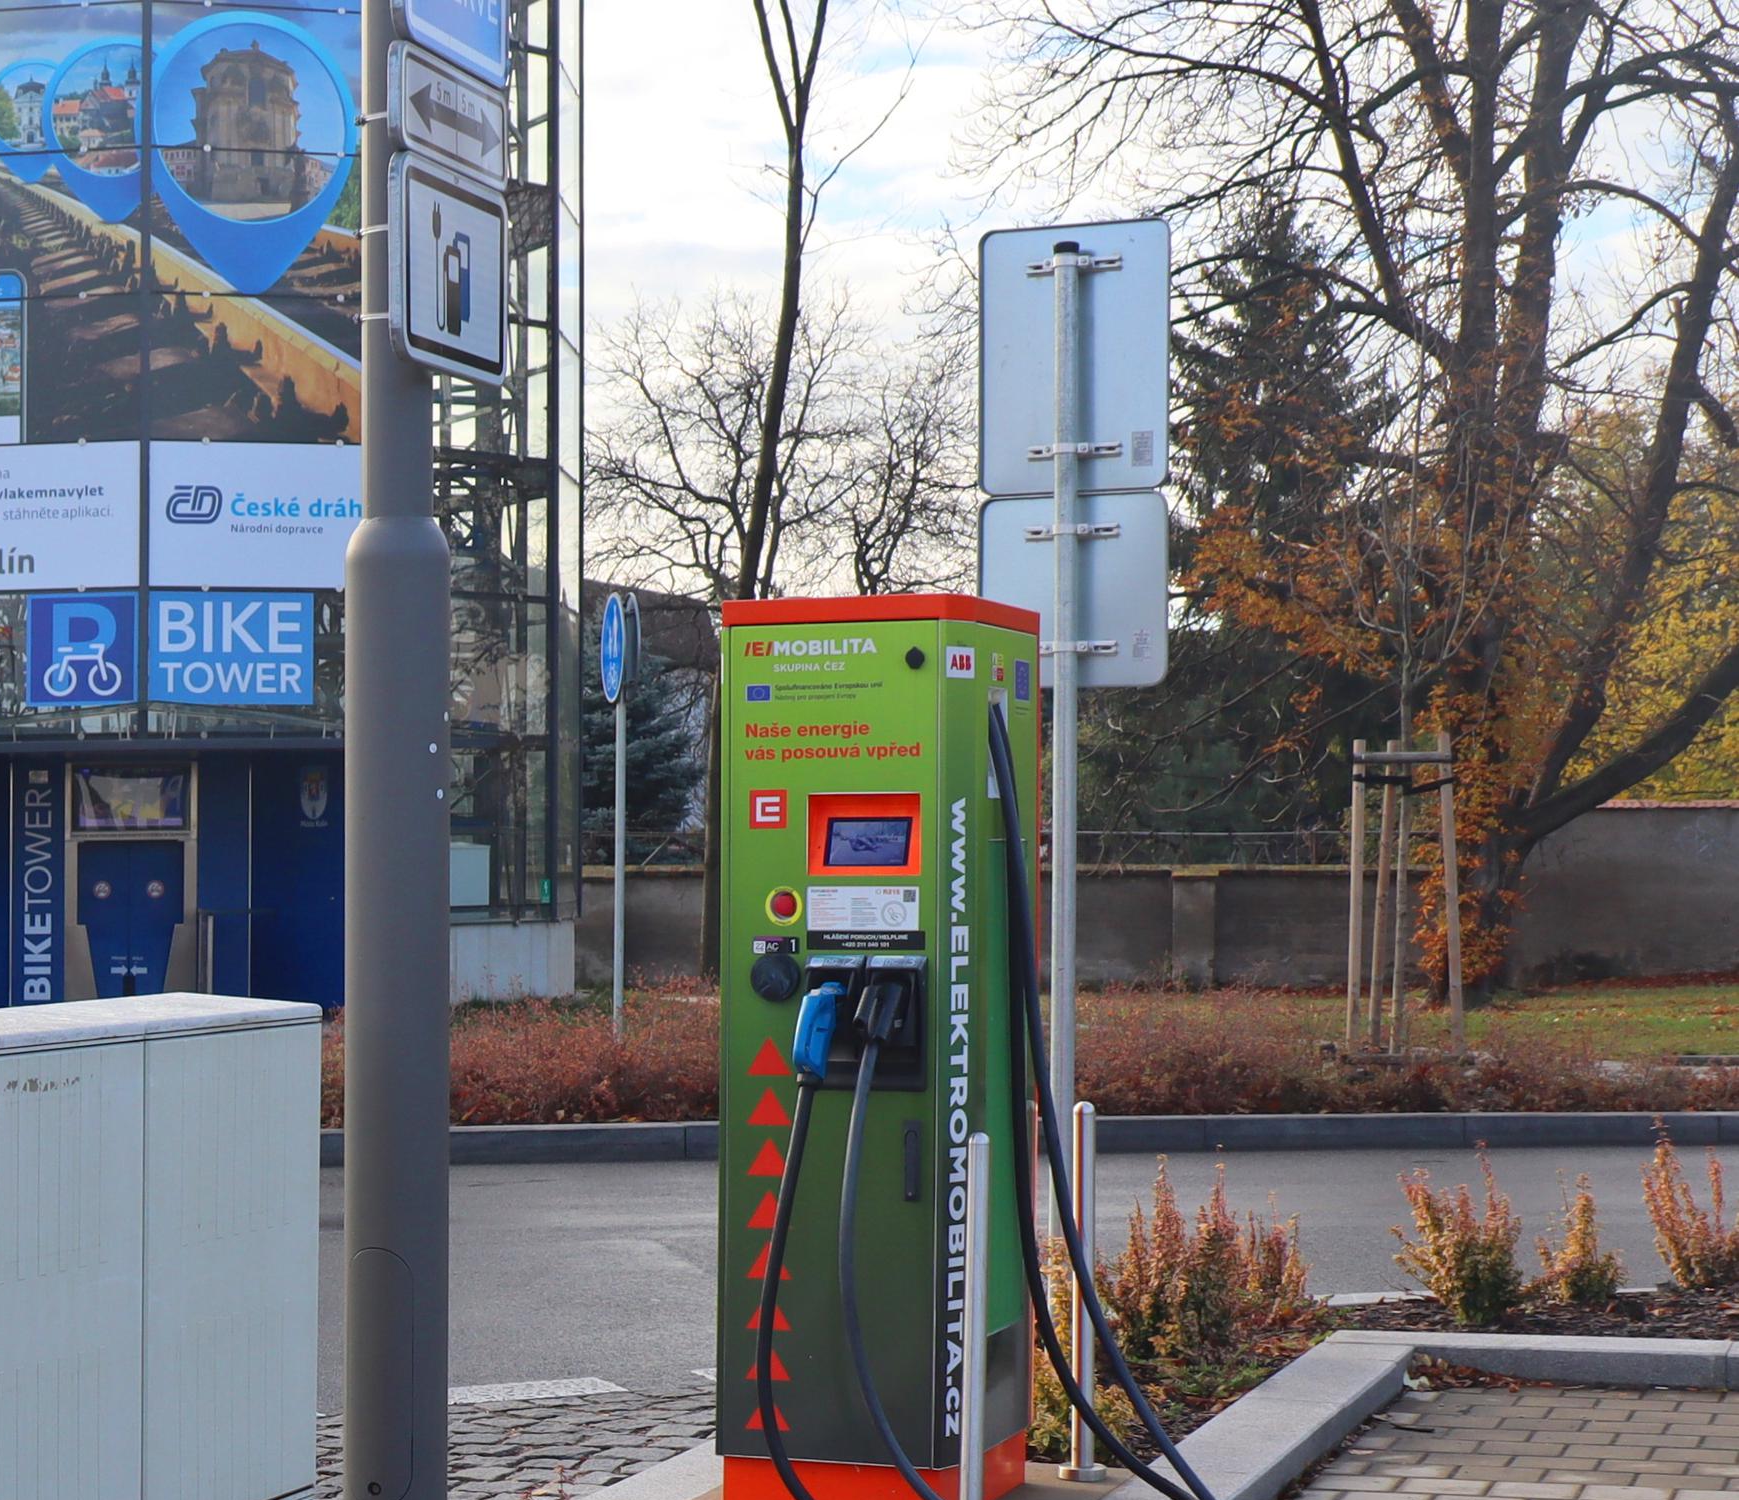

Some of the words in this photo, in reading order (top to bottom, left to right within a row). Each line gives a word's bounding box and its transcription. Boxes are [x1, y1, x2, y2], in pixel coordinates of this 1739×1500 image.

[3, 507, 59, 521] stáhněte
[231, 493, 300, 517] České
[308, 496, 363, 518] dráh
[231, 523, 273, 534] Národní
[275, 524, 323, 536] dopravce
[159, 600, 302, 653] BIKE
[773, 662, 820, 673] SKUPINA
[823, 660, 846, 671] ČEZ
[950, 653, 972, 671] ABB
[158, 661, 302, 694] TOWER
[745, 722, 791, 739] Naše
[797, 720, 870, 739] energie
[745, 745, 776, 760] vás
[781, 743, 861, 763] posouvá
[867, 742, 921, 761] vpřed
[23, 787, 53, 1001] BIKETOWER
[756, 942, 765, 951] 22
[767, 942, 779, 951] AC
[790, 939, 796, 952] 1
[944, 797, 969, 1437] www.ELEKTROMOBILITA.cz
